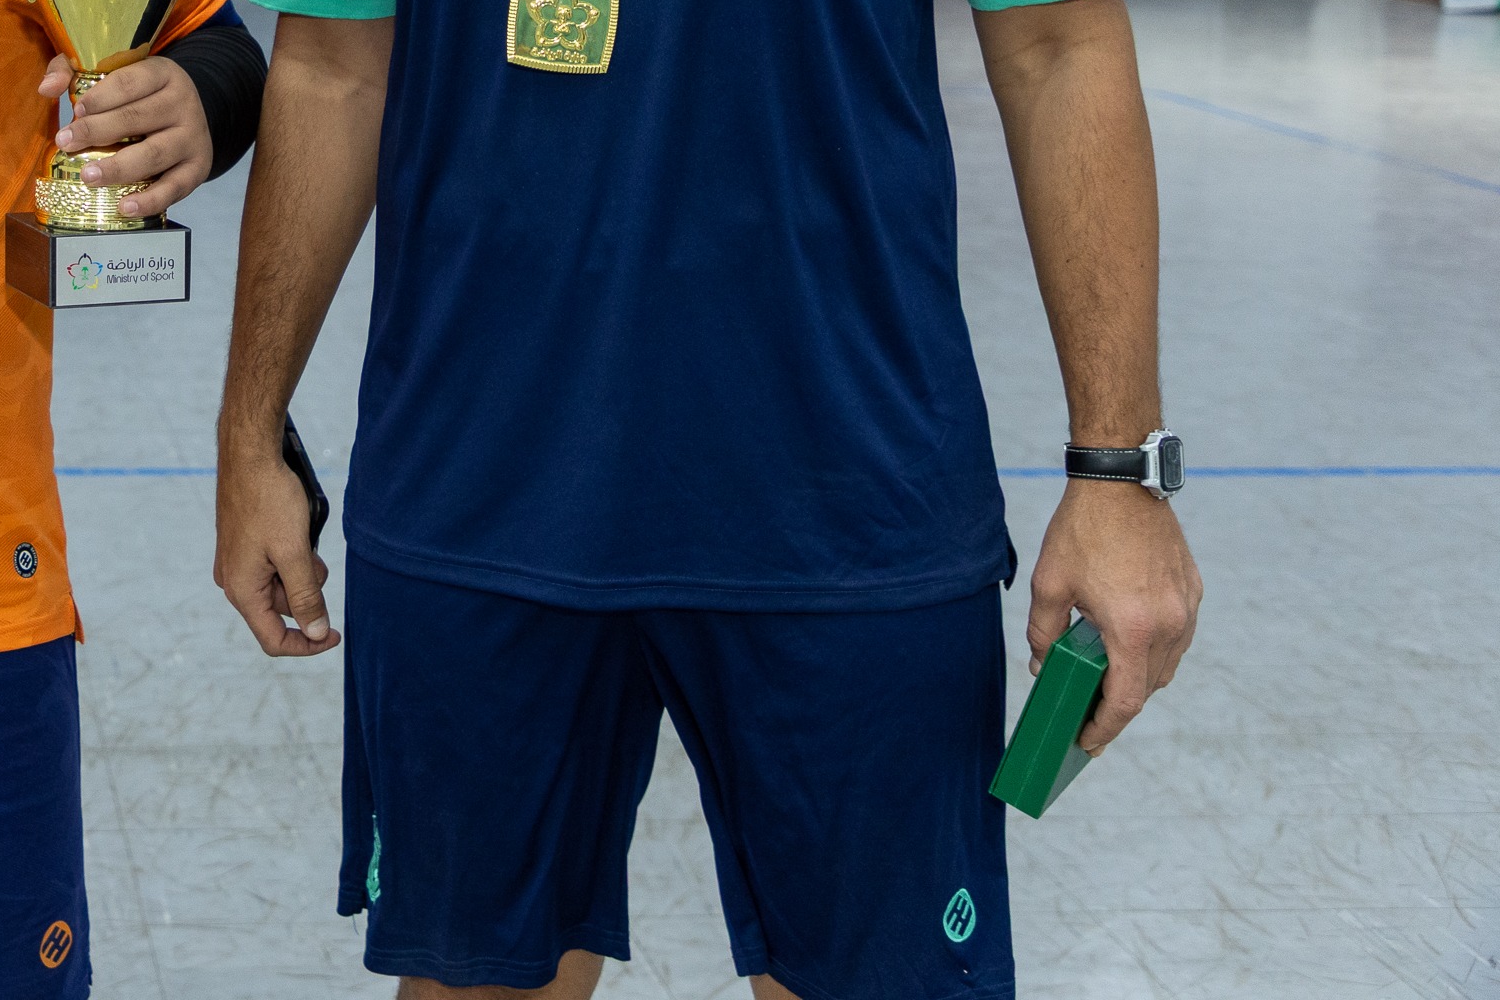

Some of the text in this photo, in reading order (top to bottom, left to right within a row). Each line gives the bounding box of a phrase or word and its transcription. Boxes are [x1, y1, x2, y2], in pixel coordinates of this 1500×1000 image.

[106, 256, 175, 272] وزارة الرياضة
[106, 271, 175, 284] Ministry of Sport
